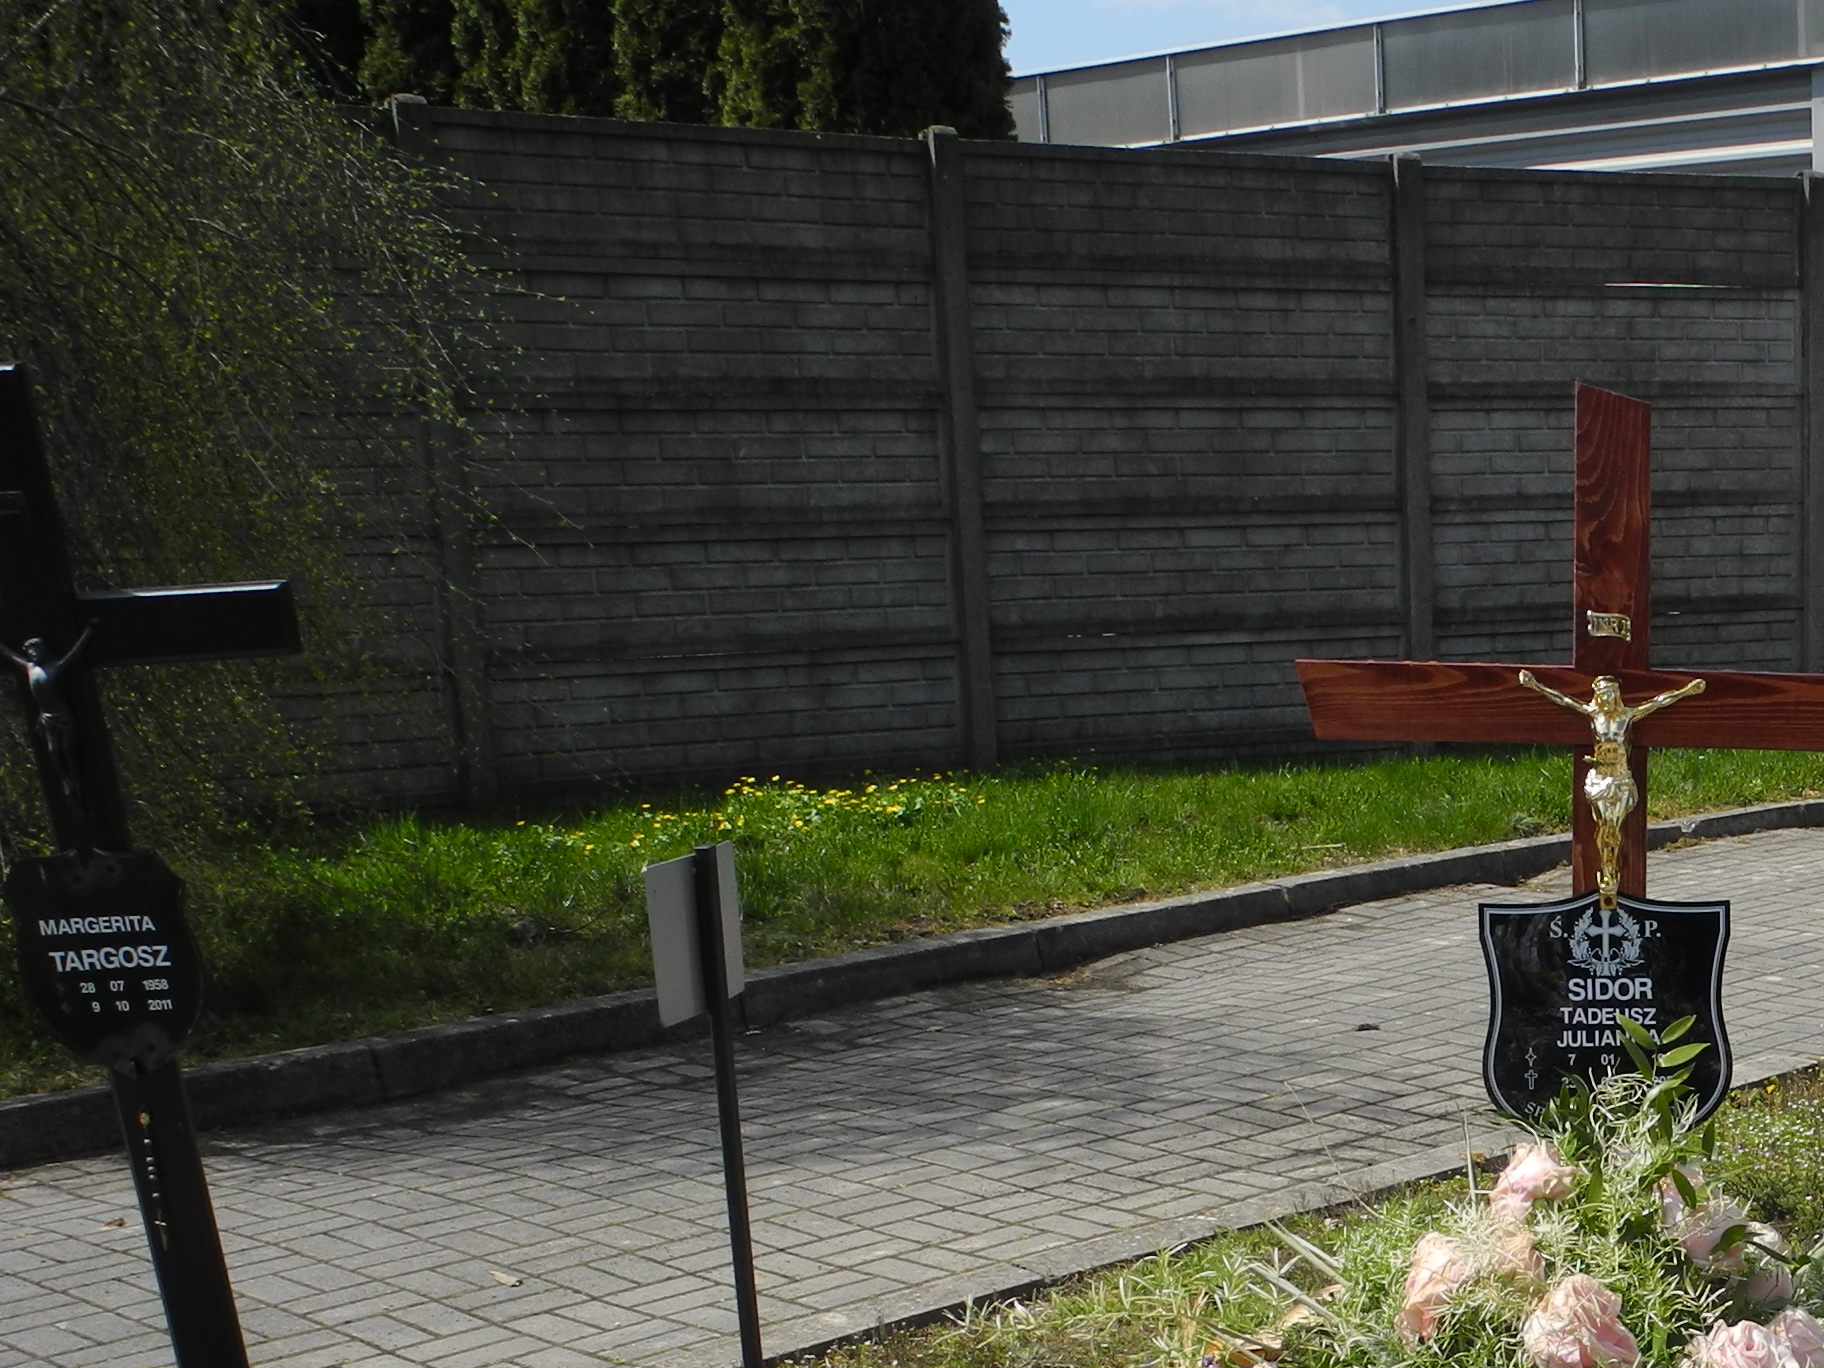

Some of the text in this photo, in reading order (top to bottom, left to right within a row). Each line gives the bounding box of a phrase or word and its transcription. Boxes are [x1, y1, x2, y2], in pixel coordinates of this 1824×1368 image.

[38, 915, 156, 936] MARGERITA
[48, 945, 172, 972] TARGOSZ
[80, 981, 96, 994] 28
[109, 980, 125, 992] 07
[1567, 977, 1653, 1001] SIDOR
[91, 999, 173, 1013] 9 10 2011
[1556, 1028, 1660, 1048] JULIAA
[1568, 1054, 1577, 1066] 7
[1600, 1053, 1615, 1066] 01
